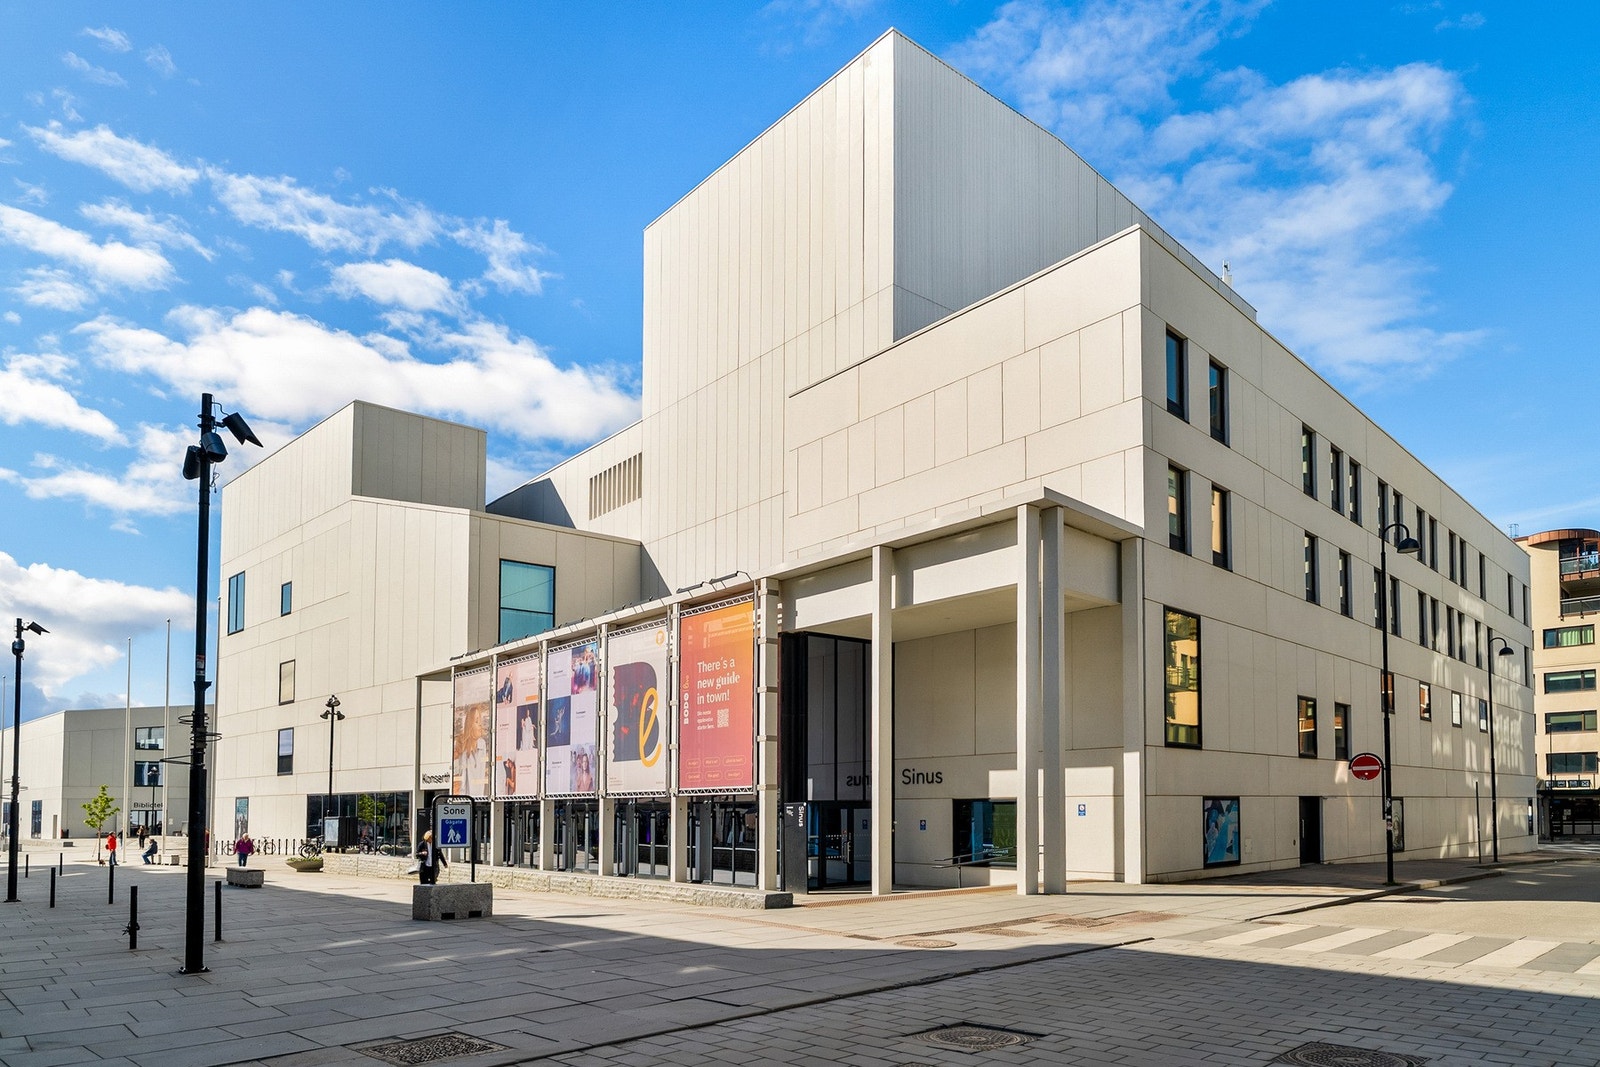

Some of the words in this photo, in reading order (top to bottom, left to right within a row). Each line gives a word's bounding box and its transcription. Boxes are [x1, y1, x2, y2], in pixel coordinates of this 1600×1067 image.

[730, 658, 735, 667] a
[697, 678, 715, 689] new
[716, 671, 740, 689] guide
[697, 693, 704, 705] in
[706, 689, 730, 704] town!
[902, 768, 943, 785] Sinus
[443, 806, 466, 815] Sone
